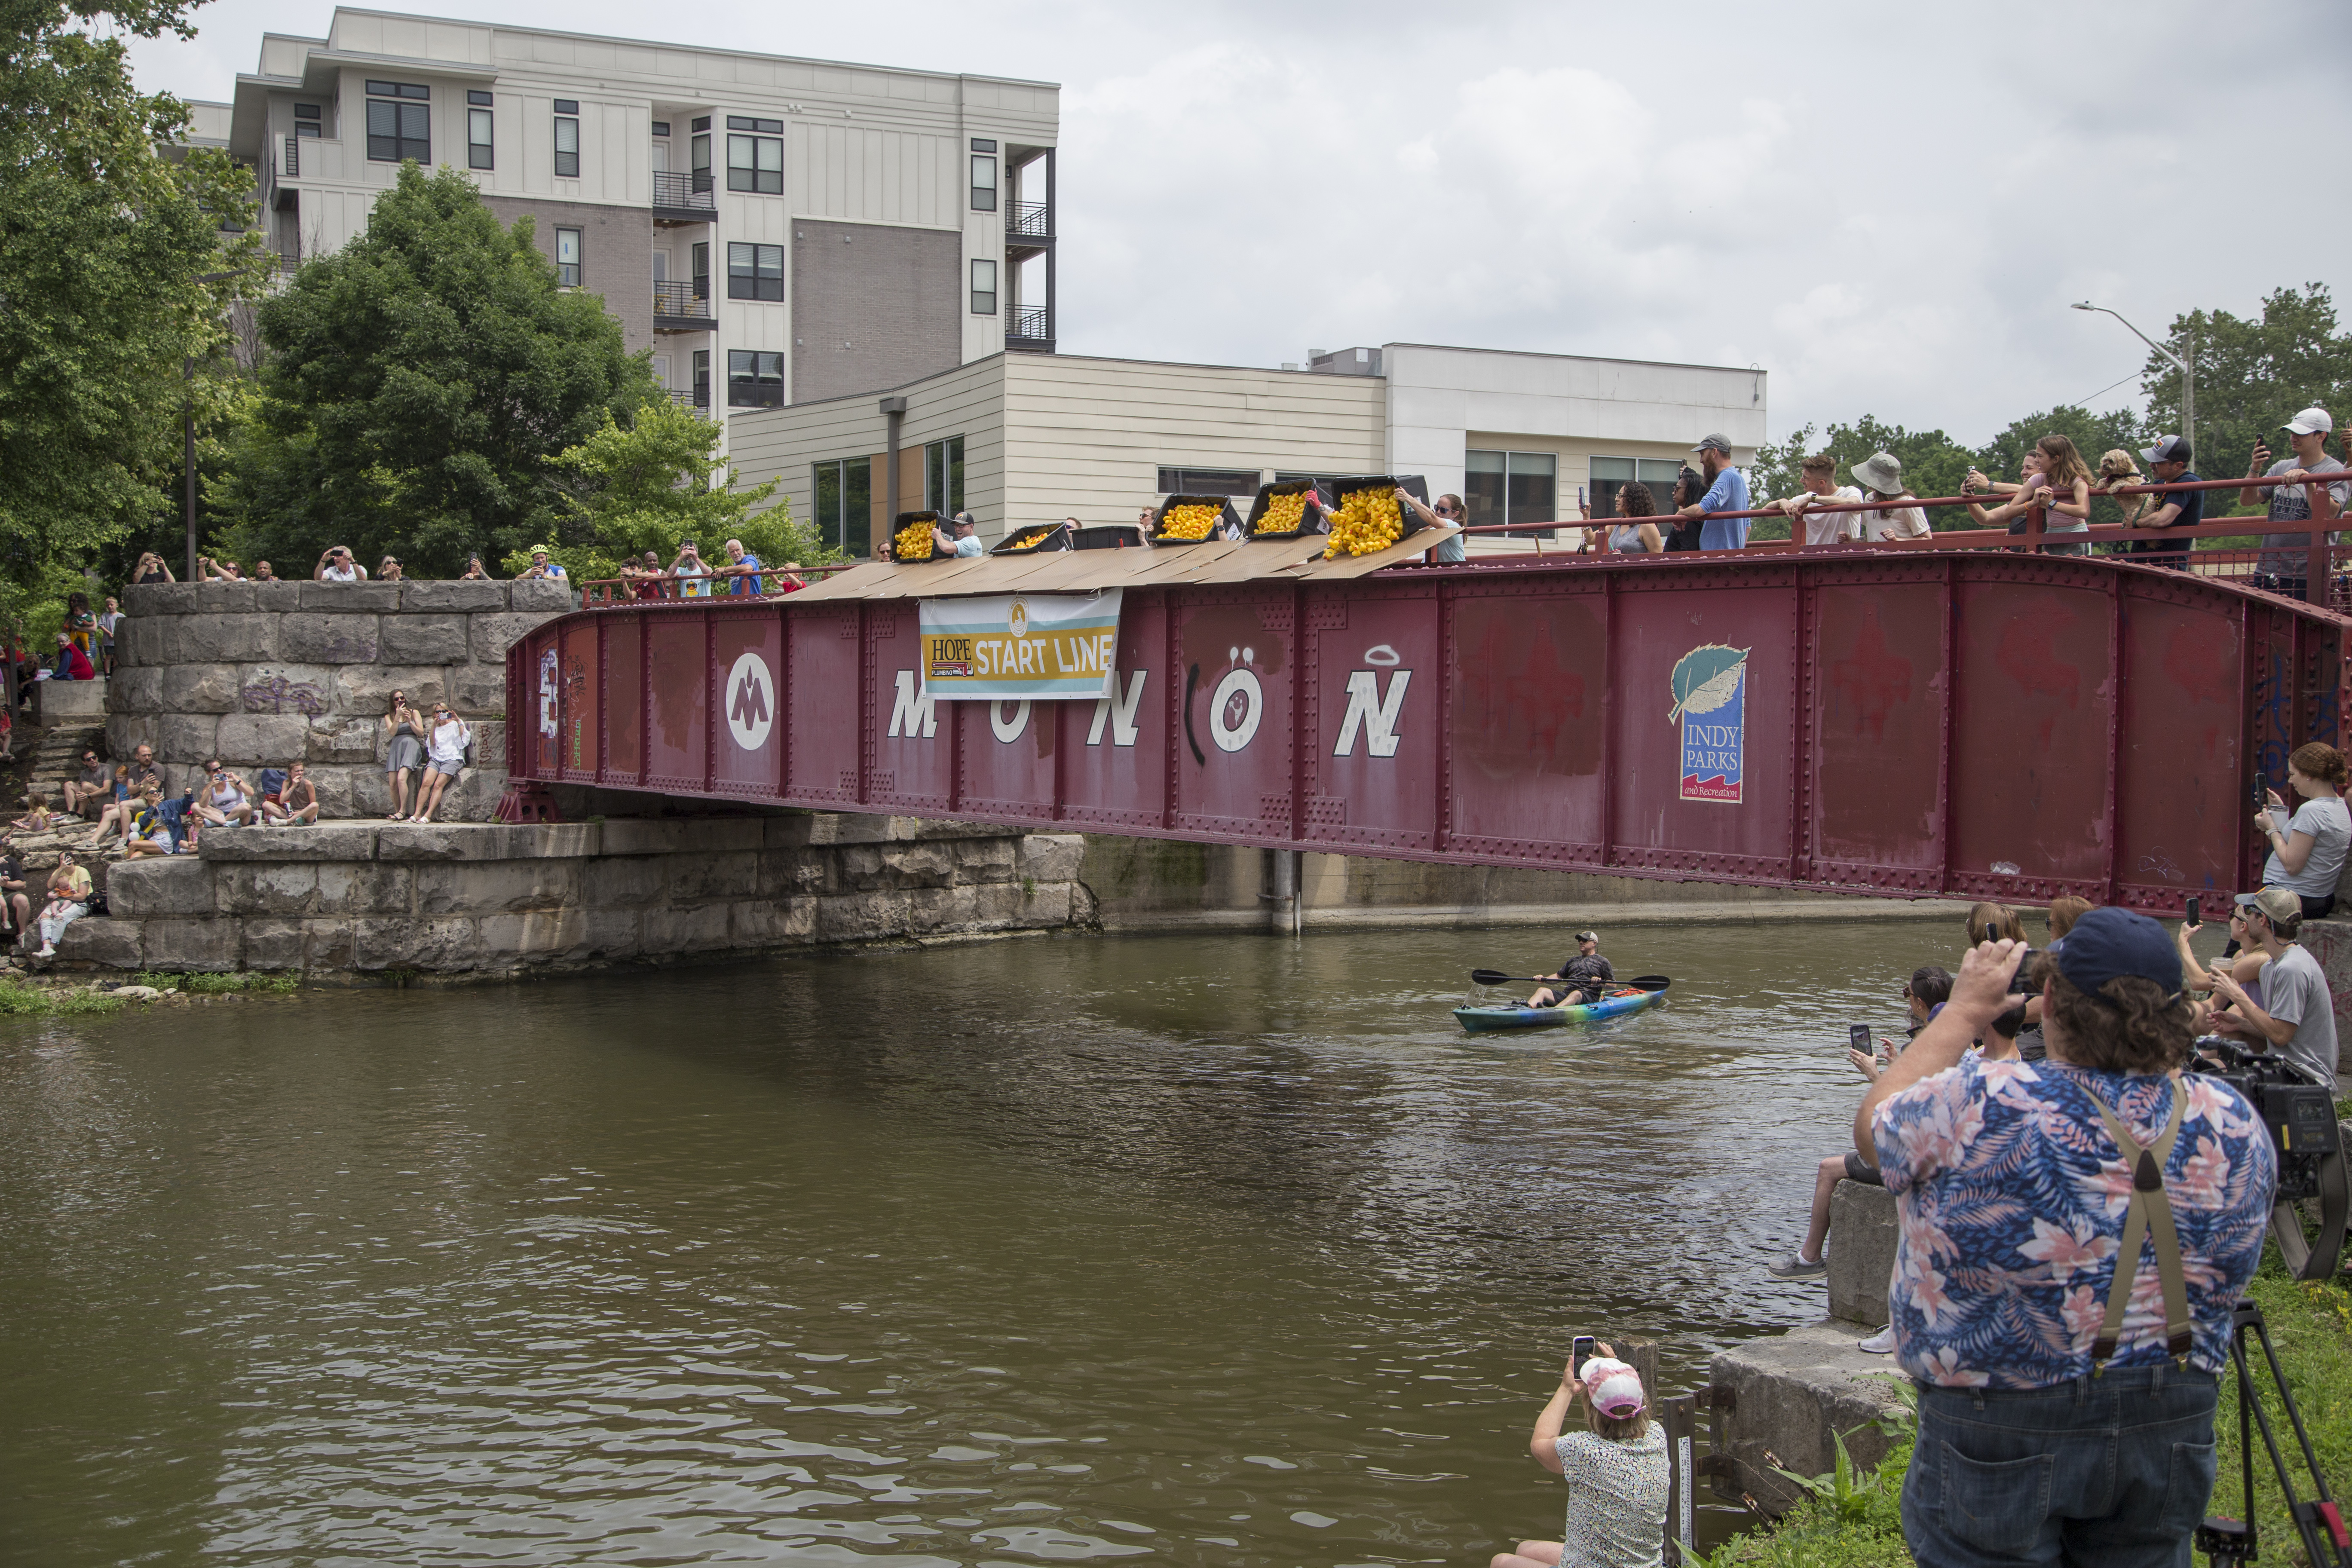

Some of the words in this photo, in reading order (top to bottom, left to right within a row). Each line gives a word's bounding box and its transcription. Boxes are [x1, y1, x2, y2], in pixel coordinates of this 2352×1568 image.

[2273, 493, 2309, 509] KRON
[2270, 505, 2309, 520] IPS
[932, 639, 971, 661] HOPE
[976, 640, 1046, 674] START
[1055, 634, 1113, 673] LINE
[1687, 725, 1740, 747] INDY
[1686, 750, 1737, 771] PARKS
[1684, 785, 1698, 795] and
[1699, 787, 1737, 798] Recreation
